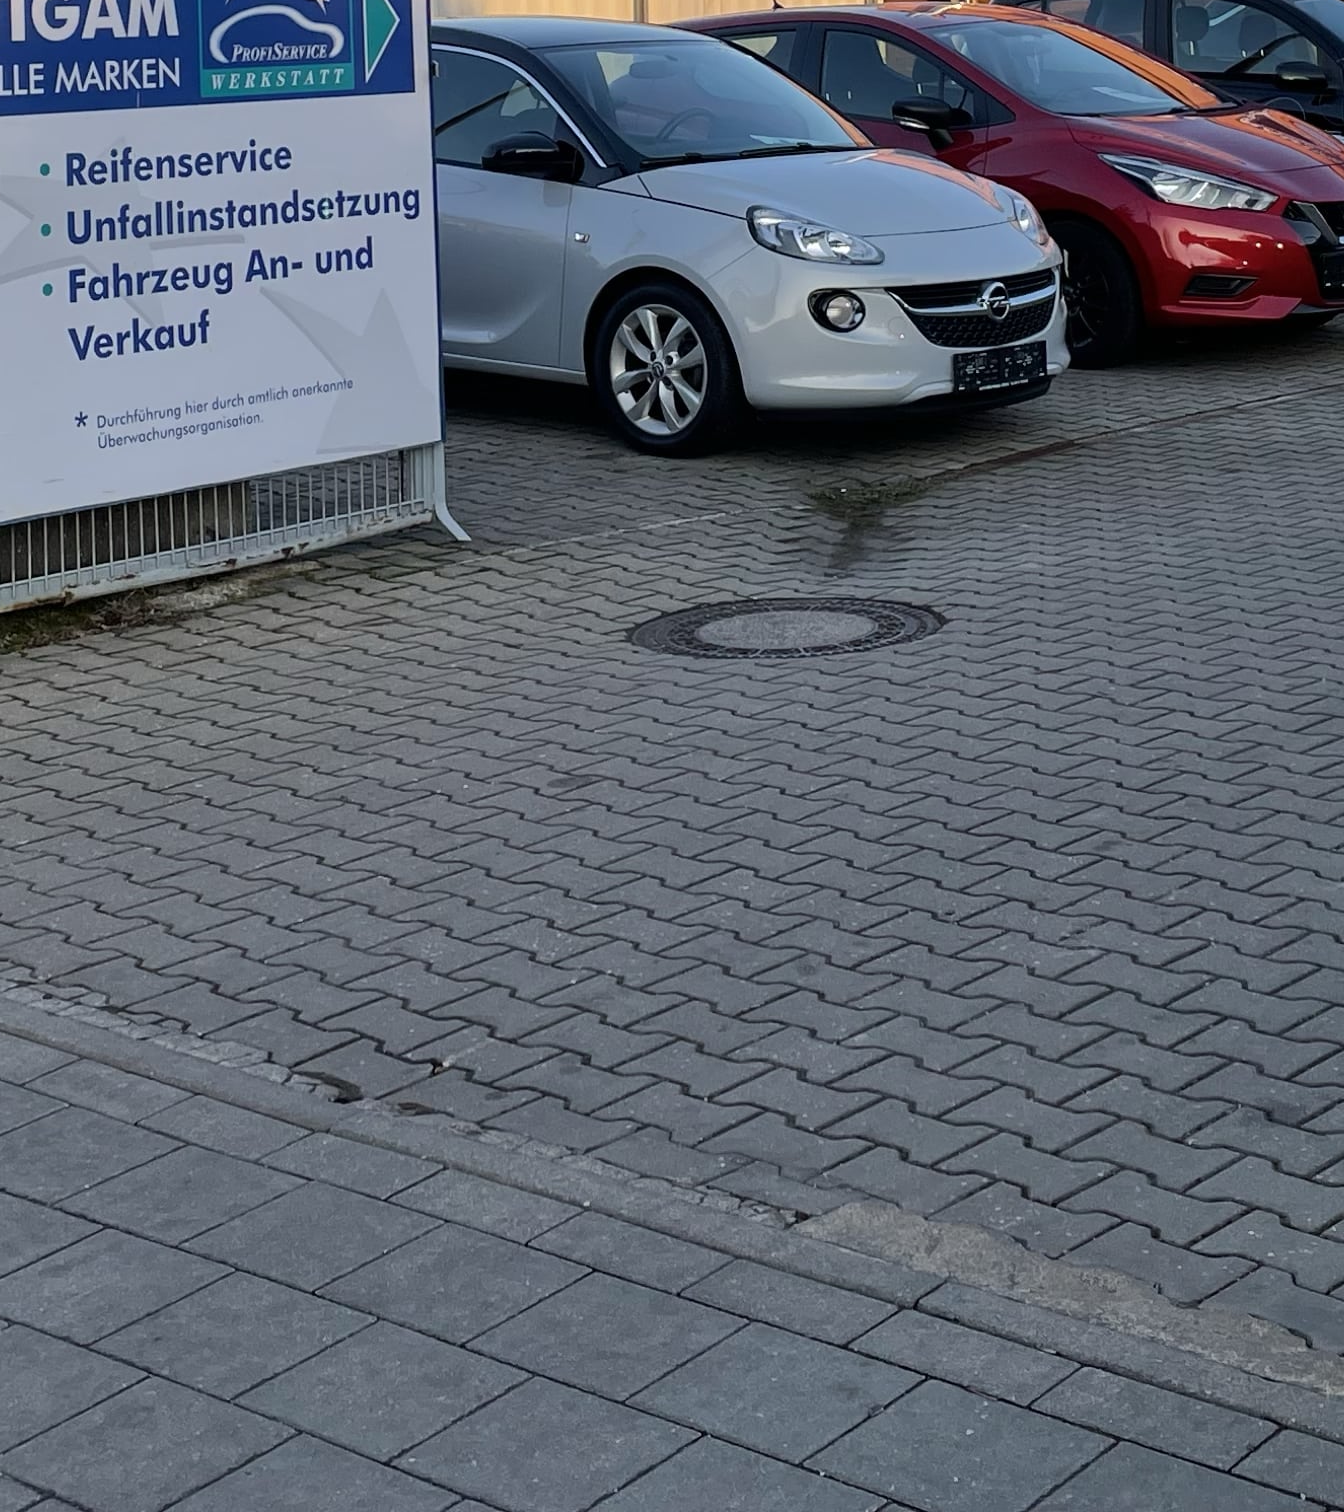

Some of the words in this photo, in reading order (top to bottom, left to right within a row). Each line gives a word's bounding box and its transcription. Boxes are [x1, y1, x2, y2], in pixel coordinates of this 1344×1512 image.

[55, 57, 181, 95] MARKEN
[210, 67, 346, 91] WERKSTATT
[65, 138, 293, 187] Reifenservice
[66, 186, 421, 244] Unfallinstandsetzung
[68, 260, 234, 303] Fahrzeug
[244, 248, 304, 283] An-
[314, 235, 374, 275] und
[67, 308, 211, 361] Verkauf
[96, 406, 181, 429] Durchführung
[184, 399, 209, 416] hier
[211, 393, 245, 411] durch
[247, 386, 289, 406] amtlich
[291, 377, 354, 398] anerkannte
[96, 411, 264, 450] Überwachungsorganisation.
